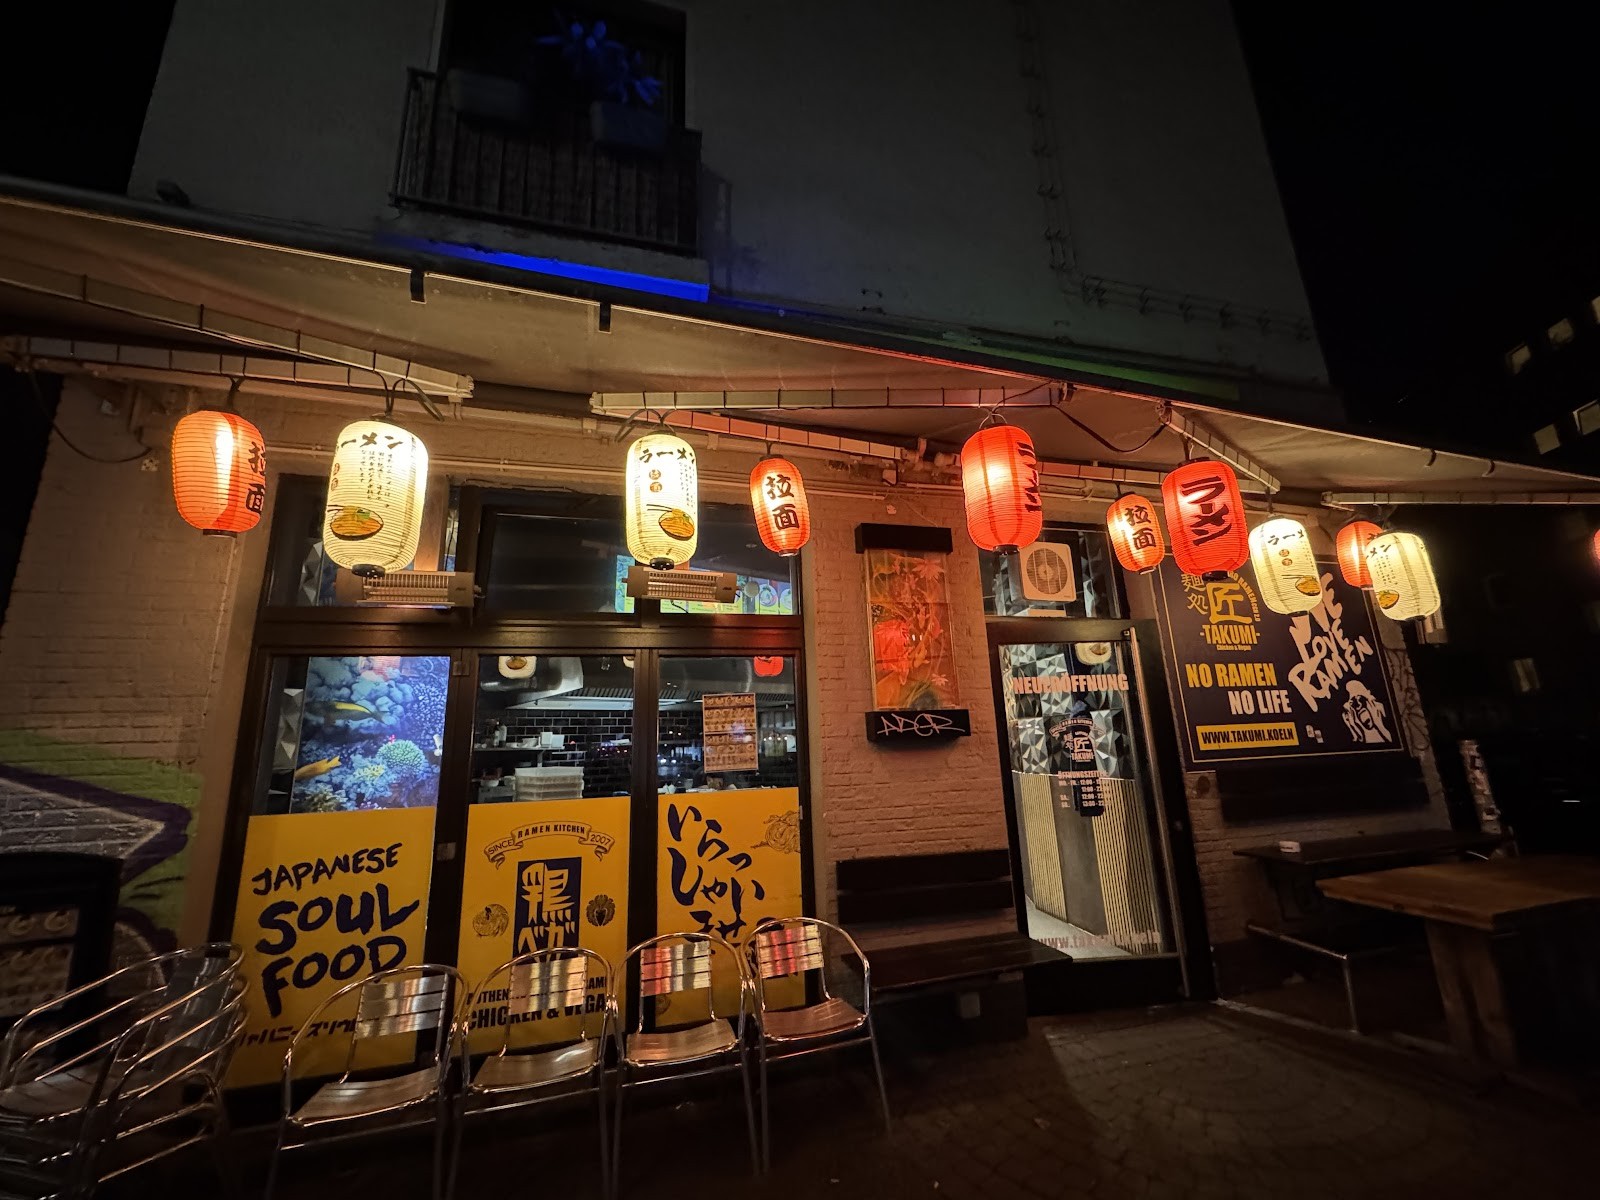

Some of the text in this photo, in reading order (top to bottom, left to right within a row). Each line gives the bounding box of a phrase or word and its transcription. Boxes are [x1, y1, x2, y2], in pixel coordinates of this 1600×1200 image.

[336, 432, 404, 451] ーメン
[246, 441, 266, 515] 拉面
[765, 473, 800, 530] 拉面
[1181, 475, 1232, 547] ラーメン
[1125, 505, 1156, 550] 拉面
[1206, 582, 1252, 624] 匠
[1289, 618, 1350, 665] LOVE
[1013, 673, 1129, 694] NEUERÖFFNUNG
[1185, 663, 1278, 688] NO RAMEN
[1288, 635, 1374, 712] RAMEN
[1228, 689, 1292, 715] NO LIFE
[1201, 728, 1294, 744] WWW.TAKUMI.KOELN
[487, 824, 611, 855] SINCE RAMEN KITCHEN 2007
[252, 843, 403, 896] JAPANESE
[255, 883, 419, 956] SOUL
[261, 936, 407, 1019] FOOD
